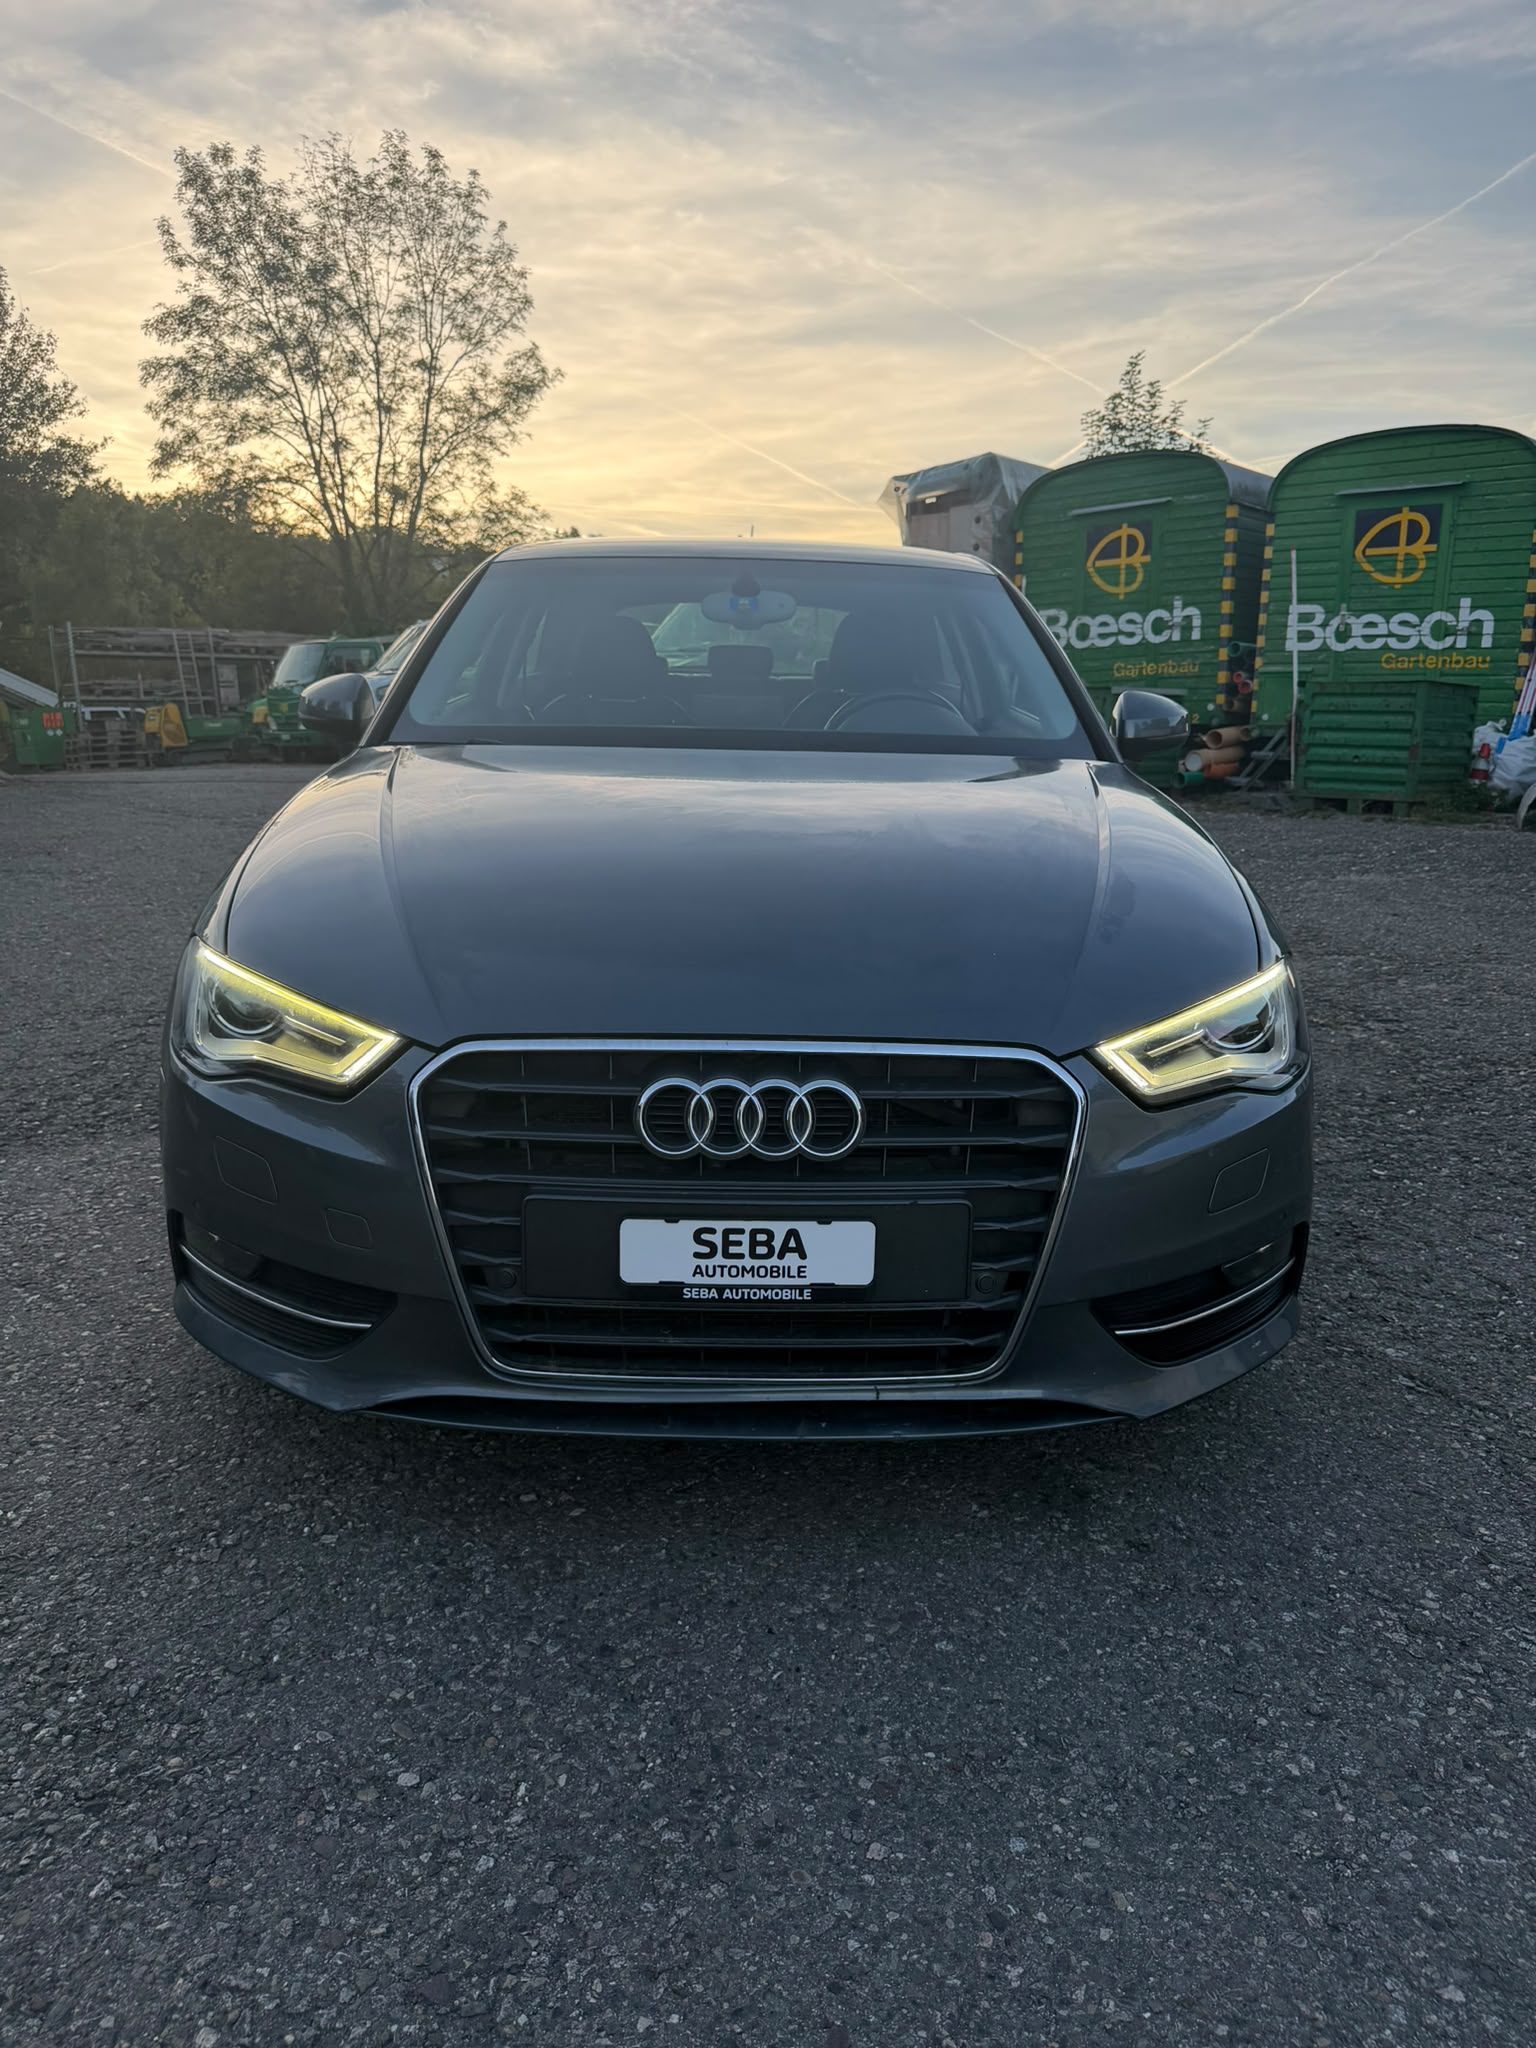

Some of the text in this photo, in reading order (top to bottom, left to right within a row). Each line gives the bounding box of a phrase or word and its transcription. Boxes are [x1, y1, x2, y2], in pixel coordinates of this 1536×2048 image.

[1113, 659, 1200, 678] Gartenbau
[1381, 651, 1490, 669] Gartenbau
[692, 1227, 808, 1260] SEBA
[692, 1264, 808, 1279] AUTOMOBILE
[683, 1287, 812, 1300] SEBA AUTOMOBILE
